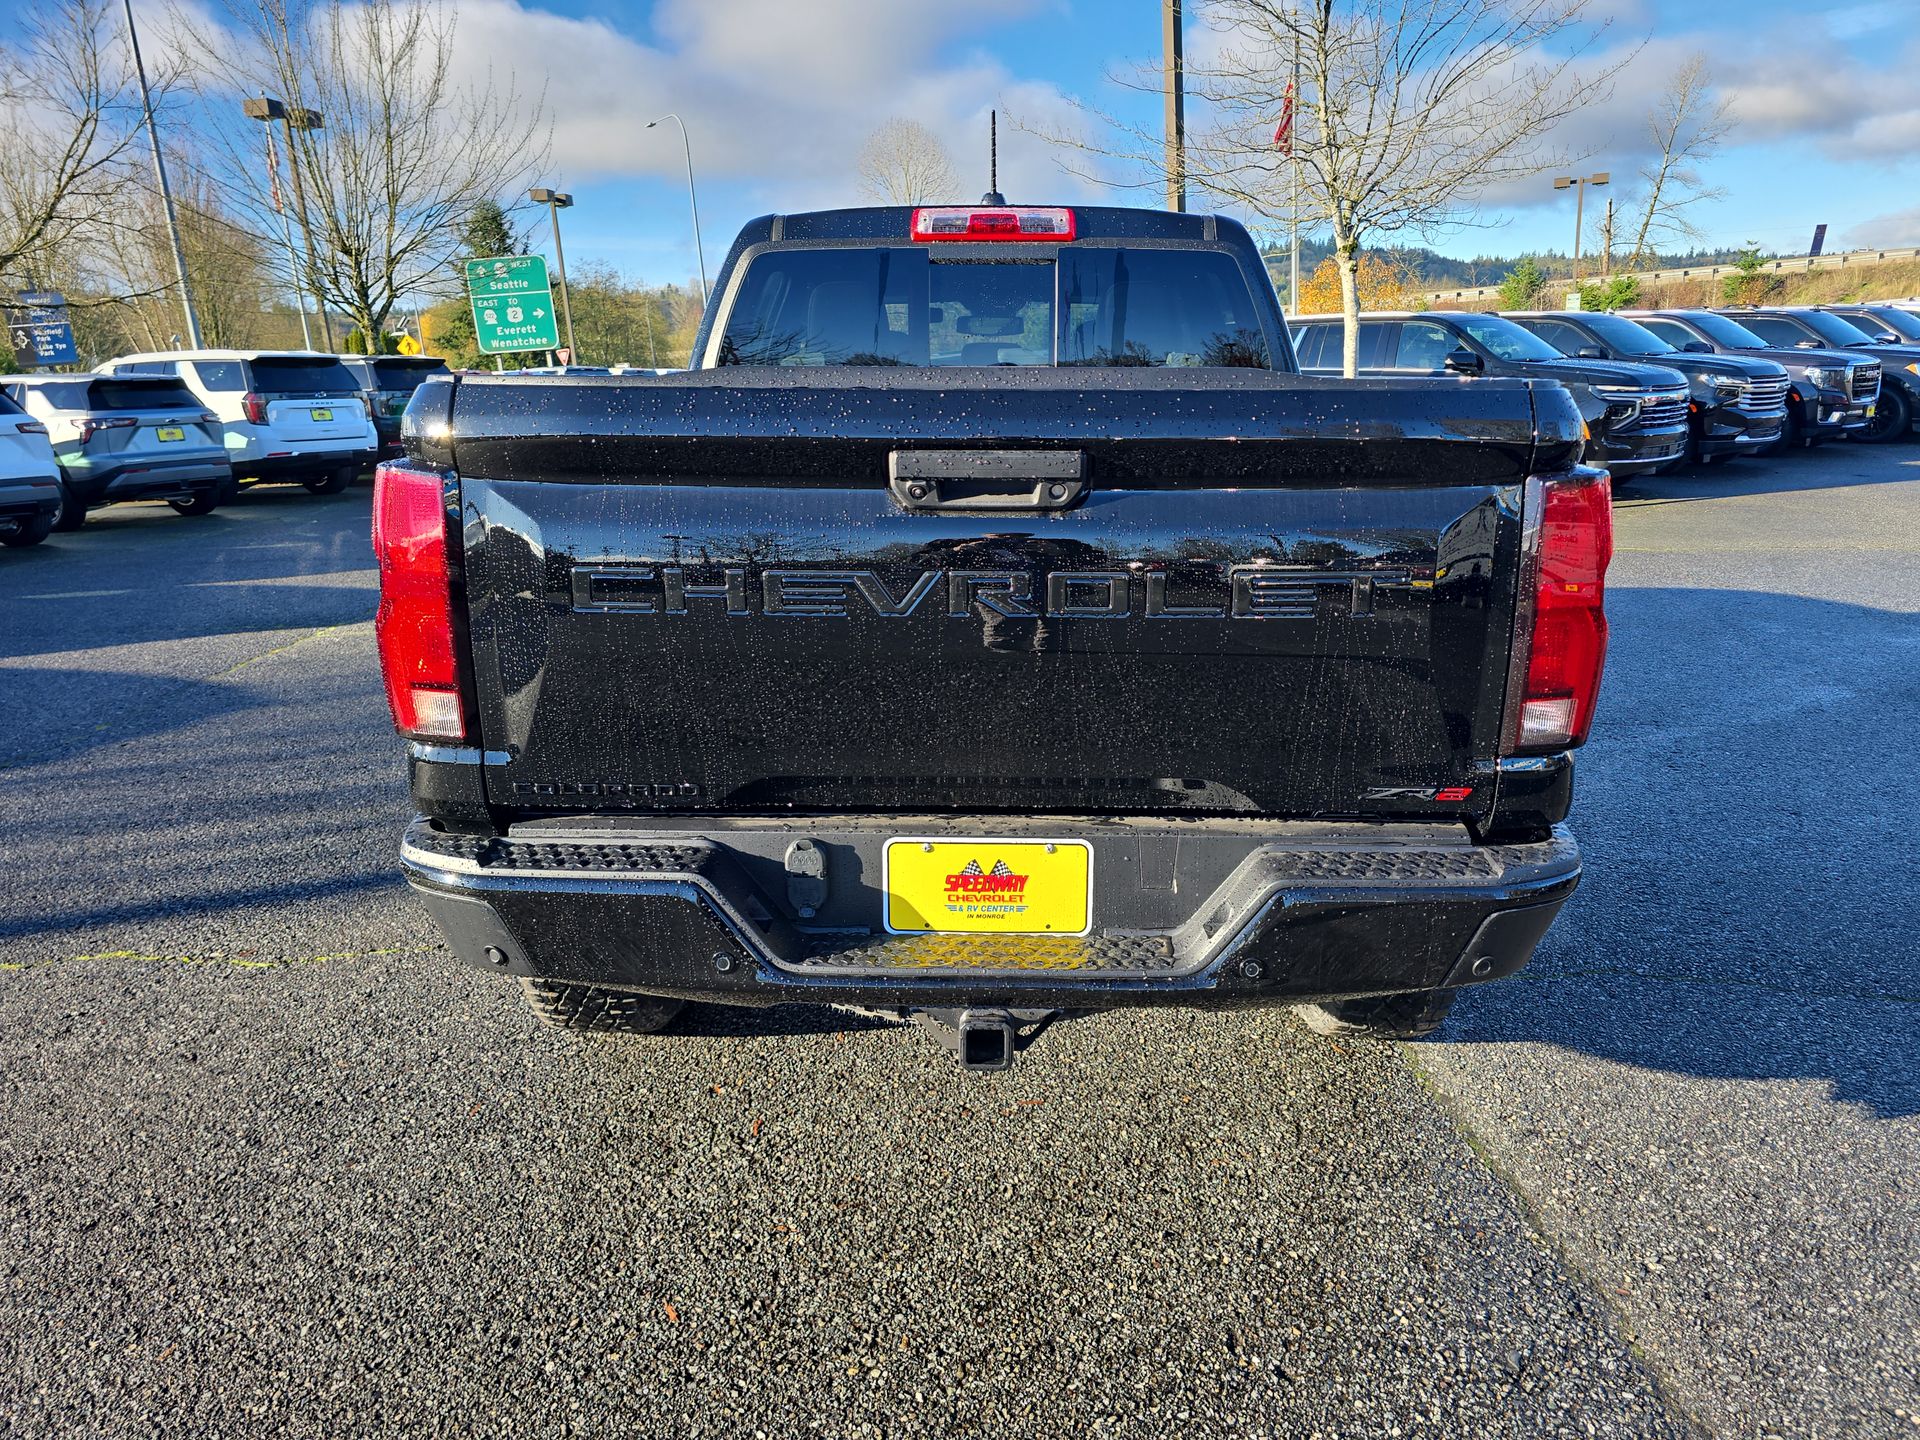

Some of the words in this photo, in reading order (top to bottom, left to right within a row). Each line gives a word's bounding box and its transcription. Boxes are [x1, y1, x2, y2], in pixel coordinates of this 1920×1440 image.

[489, 280, 529, 290] Seattle
[477, 299, 499, 307] EAST
[511, 310, 519, 319] 2
[496, 325, 537, 335] Everett
[491, 337, 548, 348] Wenatchee
[571, 565, 1412, 619] CHEVROLET
[513, 782, 699, 796] COLORADO
[1358, 787, 1473, 801] ZR2
[944, 875, 1030, 893] SPEEDWAY
[947, 894, 1025, 903] CHEVROLET
